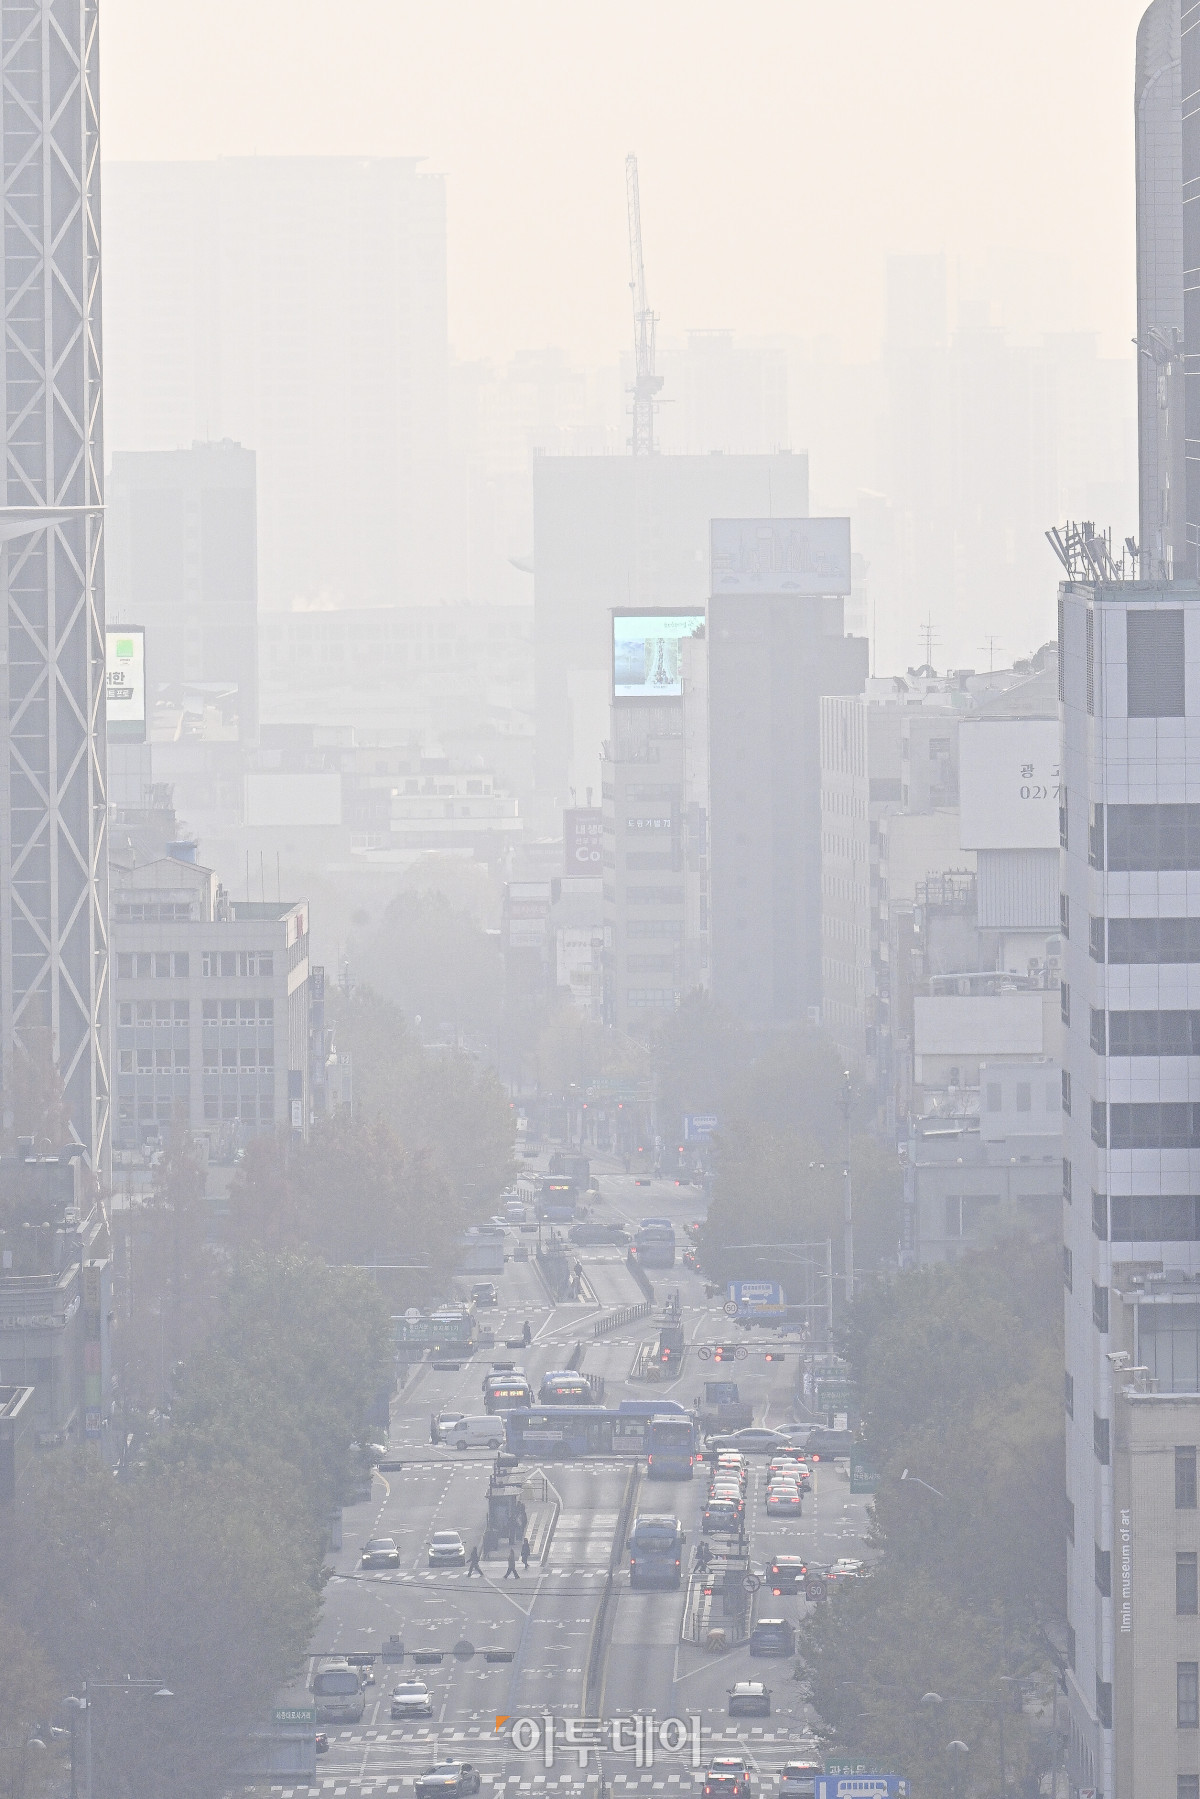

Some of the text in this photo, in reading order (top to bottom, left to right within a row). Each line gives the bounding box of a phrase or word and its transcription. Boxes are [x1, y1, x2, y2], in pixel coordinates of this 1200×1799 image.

[1120, 1508, 1131, 1525] art
[1120, 1528, 1131, 1542] of
[1122, 1545, 1131, 1598] museum
[810, 1586, 822, 1595] 50
